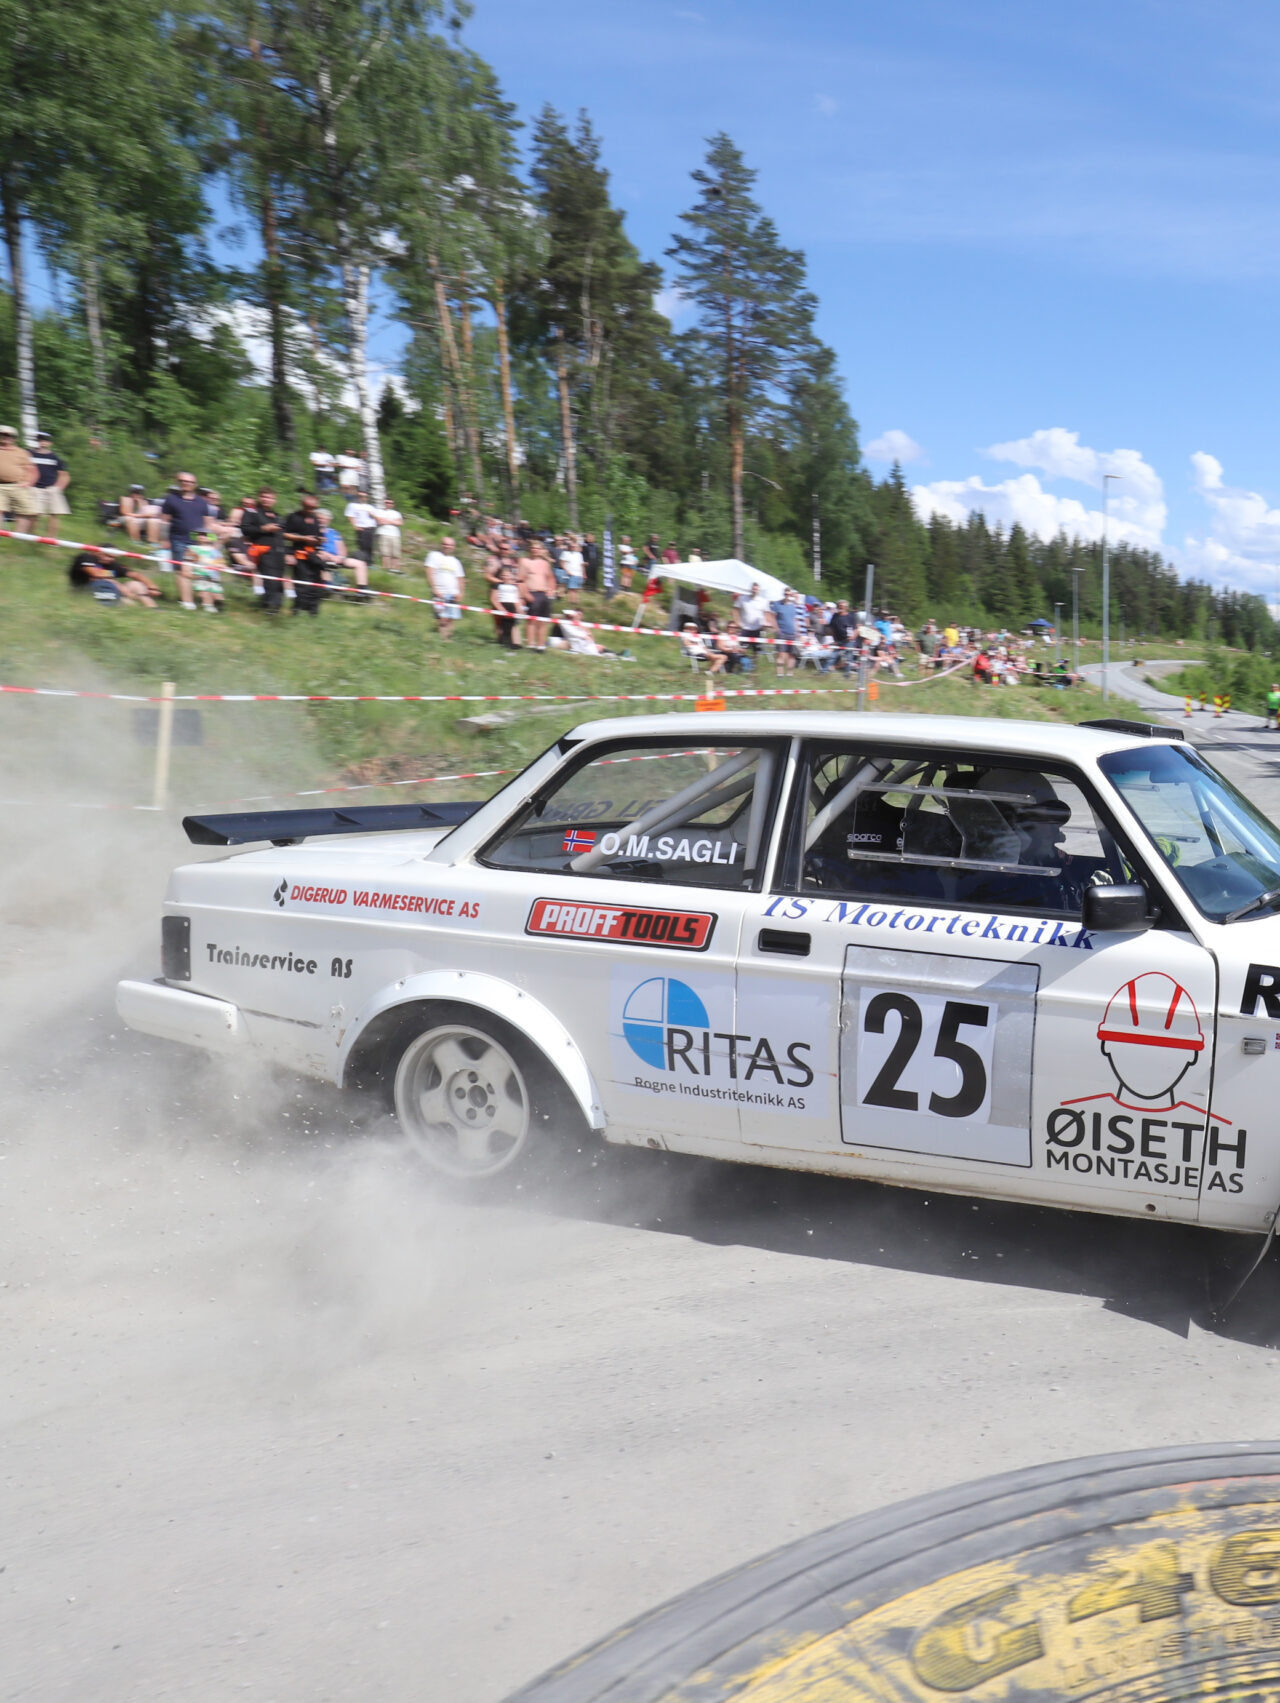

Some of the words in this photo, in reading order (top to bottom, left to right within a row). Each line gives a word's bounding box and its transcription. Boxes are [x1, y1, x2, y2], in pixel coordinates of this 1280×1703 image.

[600, 832, 738, 865] O.M.SAGLI
[290, 885, 347, 905] DIGERUD
[353, 890, 456, 916] VARMESERVICE
[458, 902, 480, 918] AS
[760, 896, 814, 920] TS
[823, 901, 1099, 950] Motorteknikk
[206, 943, 318, 975] Trainservice
[331, 957, 353, 979] AS
[666, 1027, 814, 1088] RITAS
[862, 992, 989, 1118] 25
[635, 1076, 677, 1093] Rogne
[679, 1082, 784, 1107] Industriteknikk
[787, 1096, 806, 1110] AS
[1045, 1108, 1247, 1169] ØISETH
[1046, 1148, 1199, 1188] MONTASJE
[1207, 1171, 1244, 1194] AS
